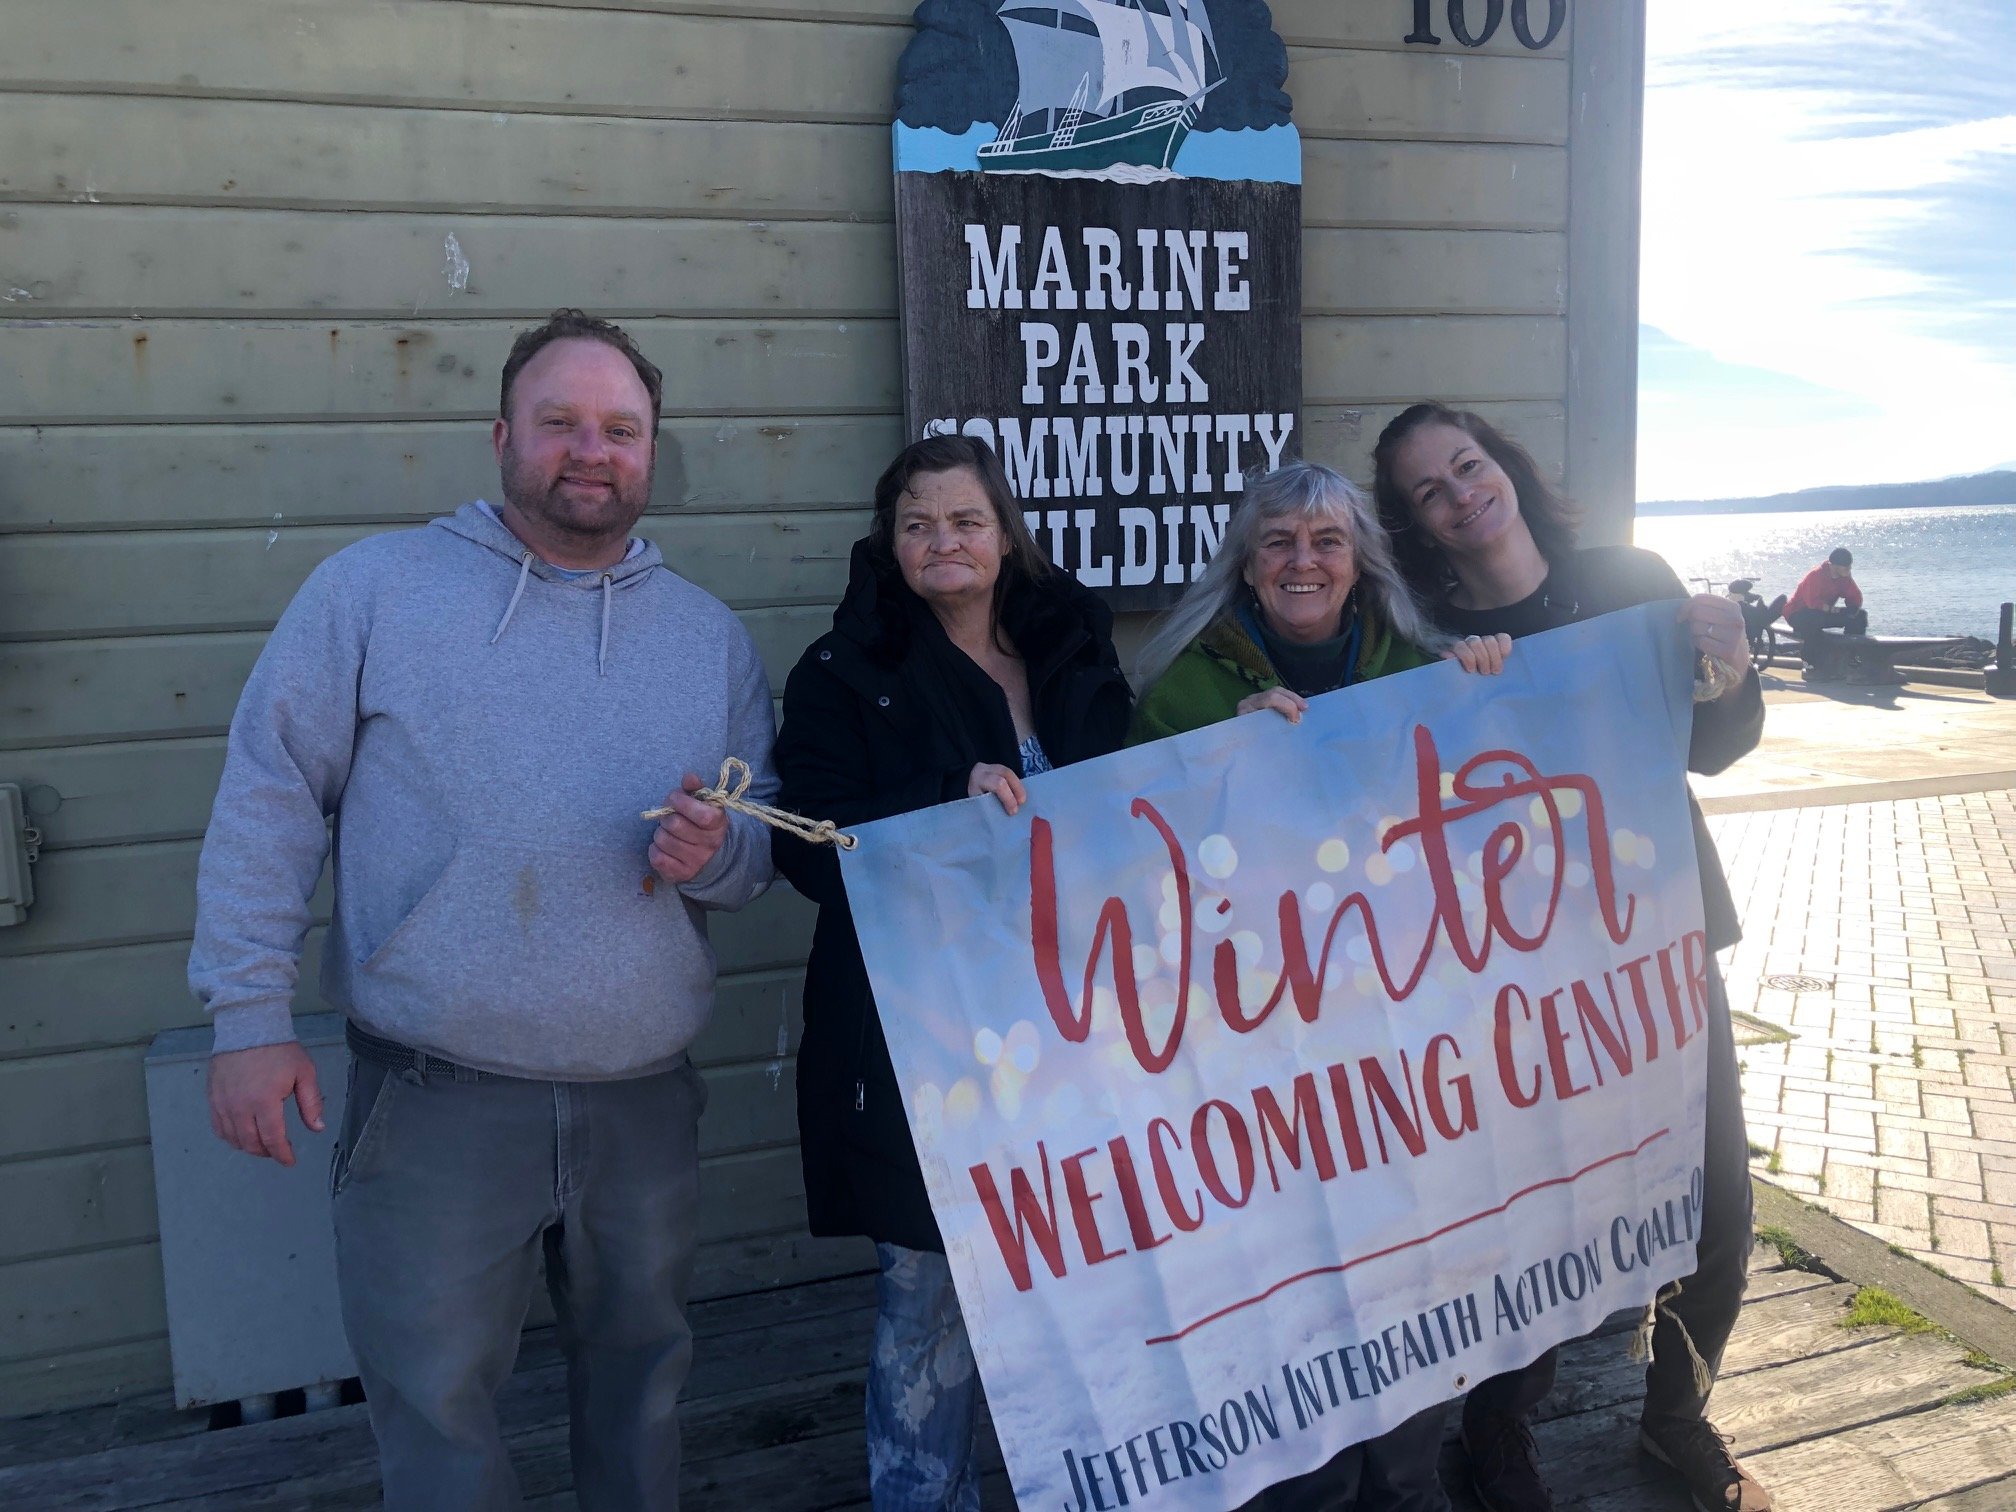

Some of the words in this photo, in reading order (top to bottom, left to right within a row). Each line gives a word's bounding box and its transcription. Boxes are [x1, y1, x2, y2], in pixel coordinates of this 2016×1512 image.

[964, 224, 1251, 311] MARINE
[1020, 322, 1209, 404] PARK
[922, 413, 1294, 499] MMUNITY
[1022, 504, 1232, 588] ILDIN
[1030, 723, 1636, 1075] Winter
[968, 1032, 1479, 1292] WELCOMING
[1493, 929, 1709, 1109] CENTER
[1062, 1384, 1281, 1512] JEFFERSON
[1281, 1292, 1483, 1430] INTERFAITH
[1494, 1238, 1602, 1336] ACTION
